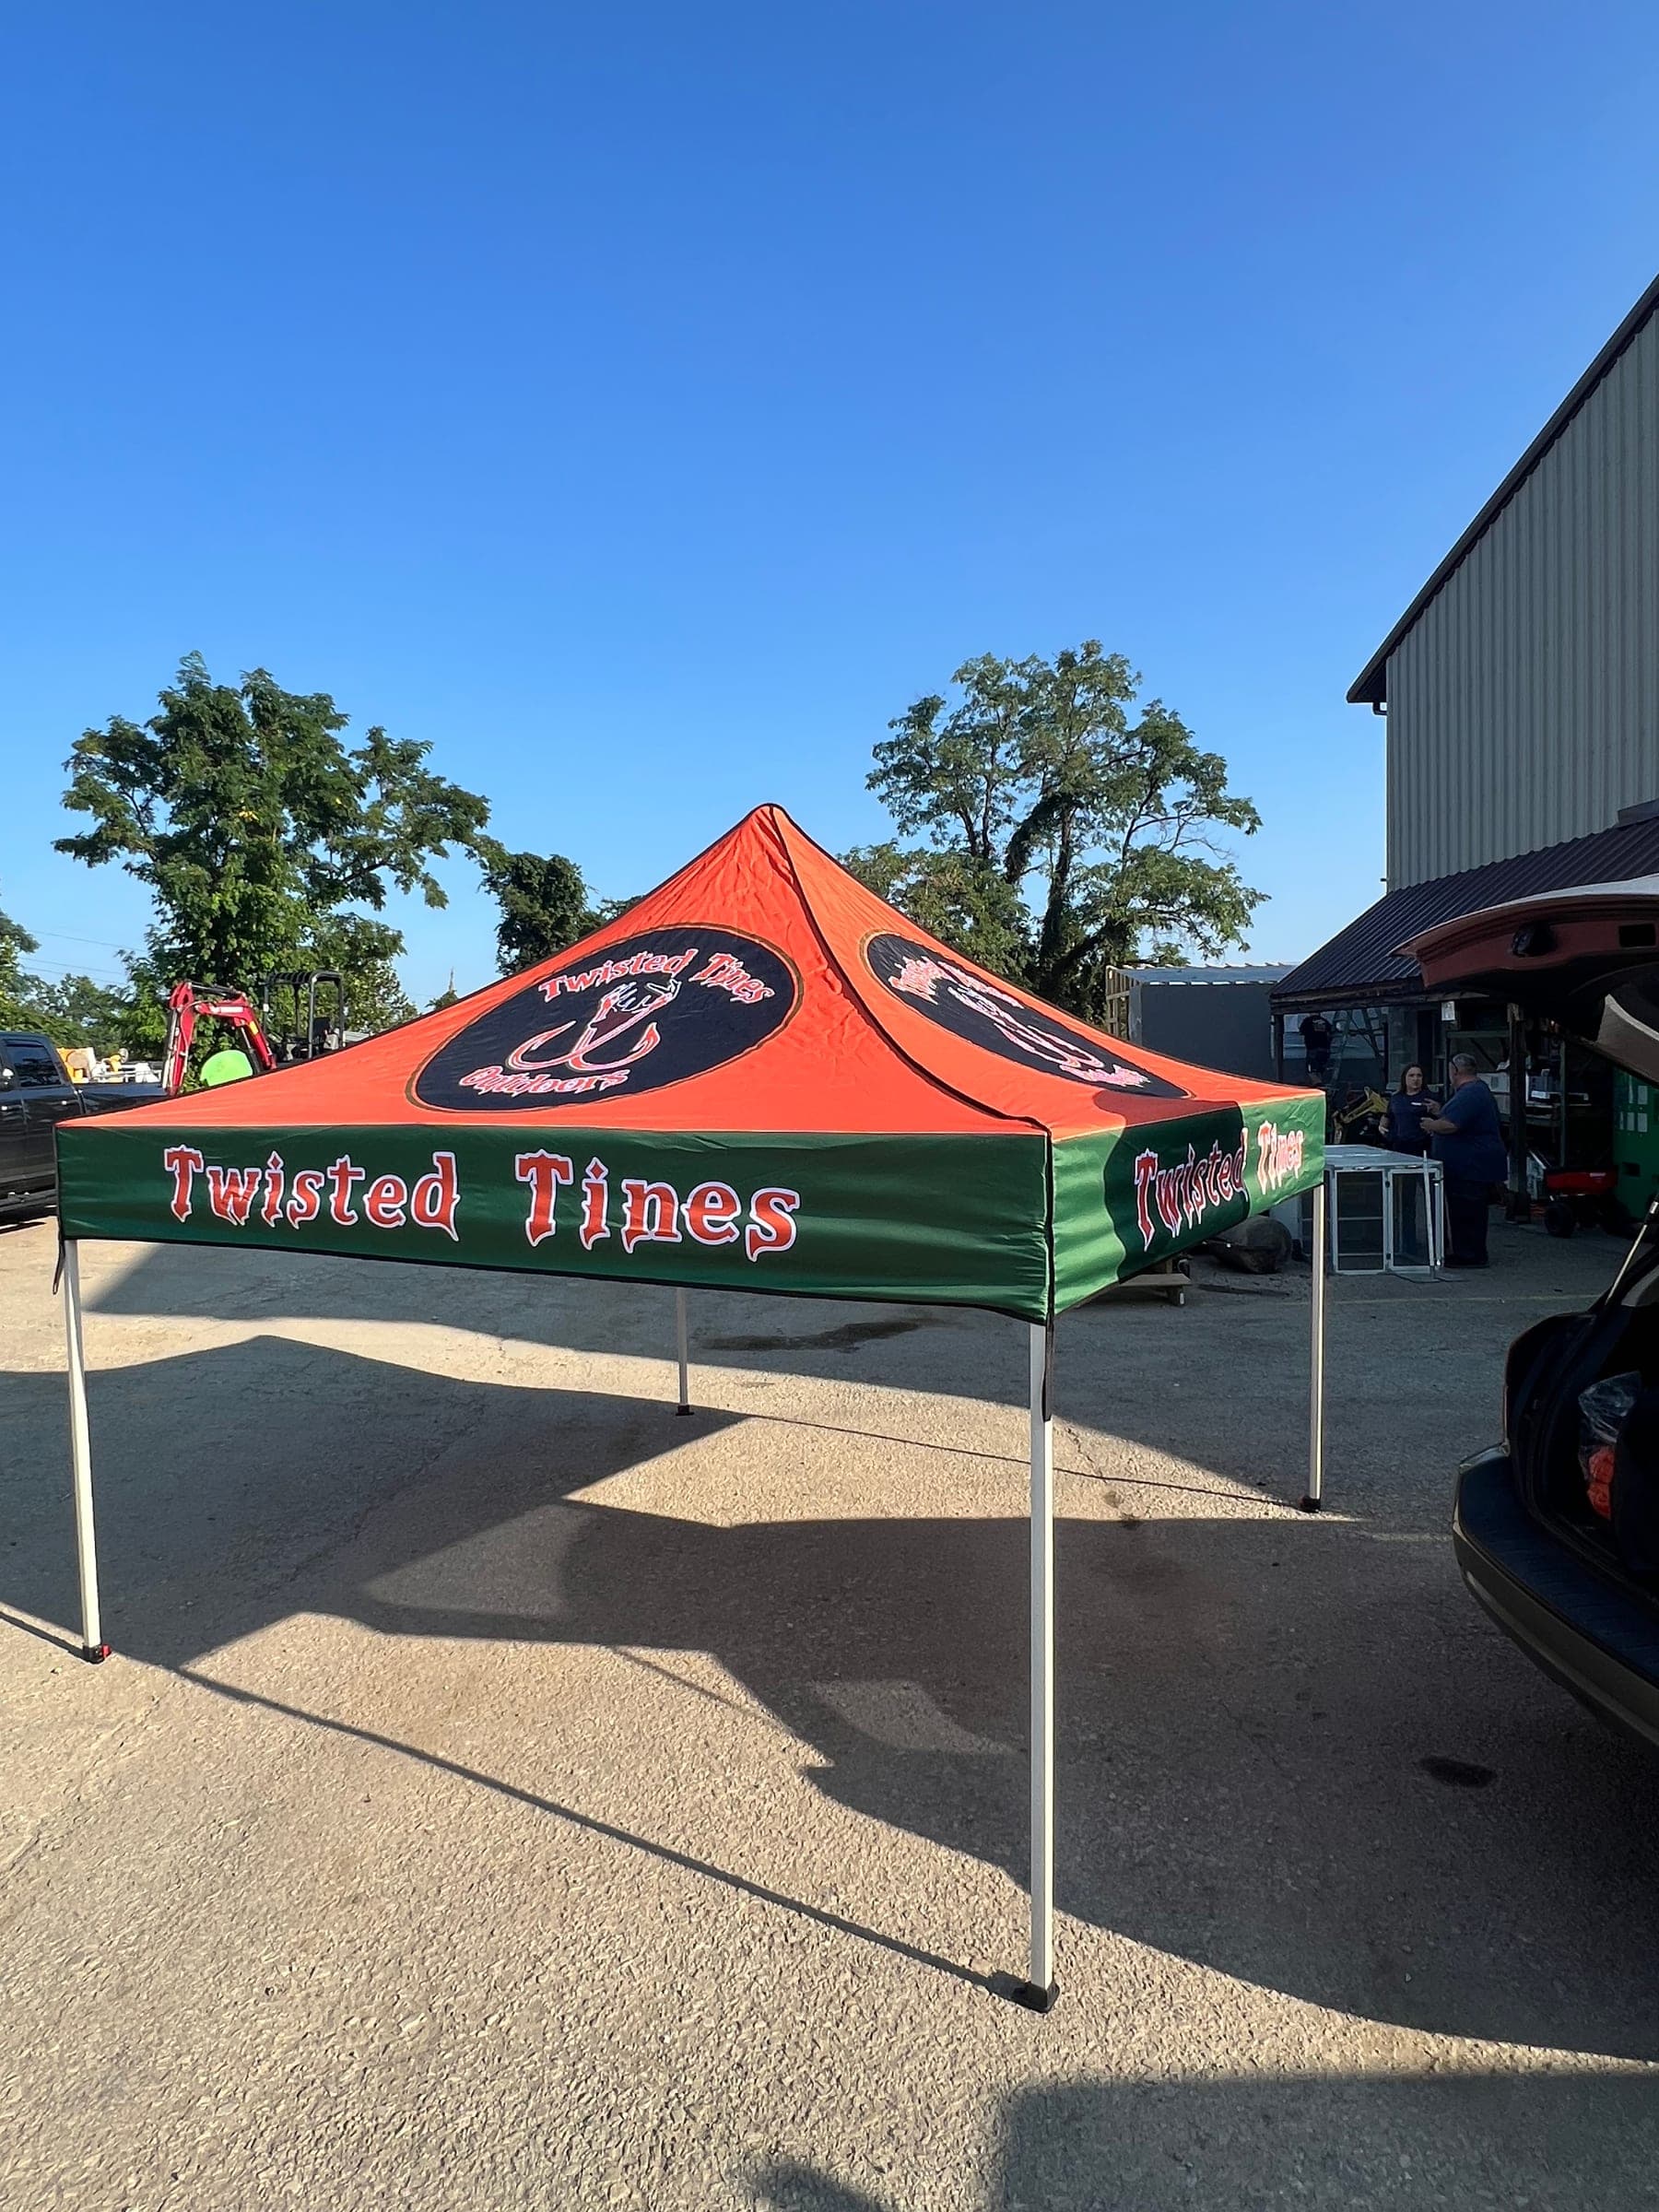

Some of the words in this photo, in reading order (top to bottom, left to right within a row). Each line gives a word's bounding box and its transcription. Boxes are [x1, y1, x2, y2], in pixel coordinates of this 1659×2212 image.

[538, 948, 699, 1003] Twisted
[688, 952, 775, 1004] Tines
[459, 1065, 630, 1097] Outdoors
[164, 1145, 460, 1241] Twisted
[515, 1149, 800, 1262] Tines
[1134, 1127, 1248, 1252] Twisted
[1257, 1120, 1304, 1194] Tines
